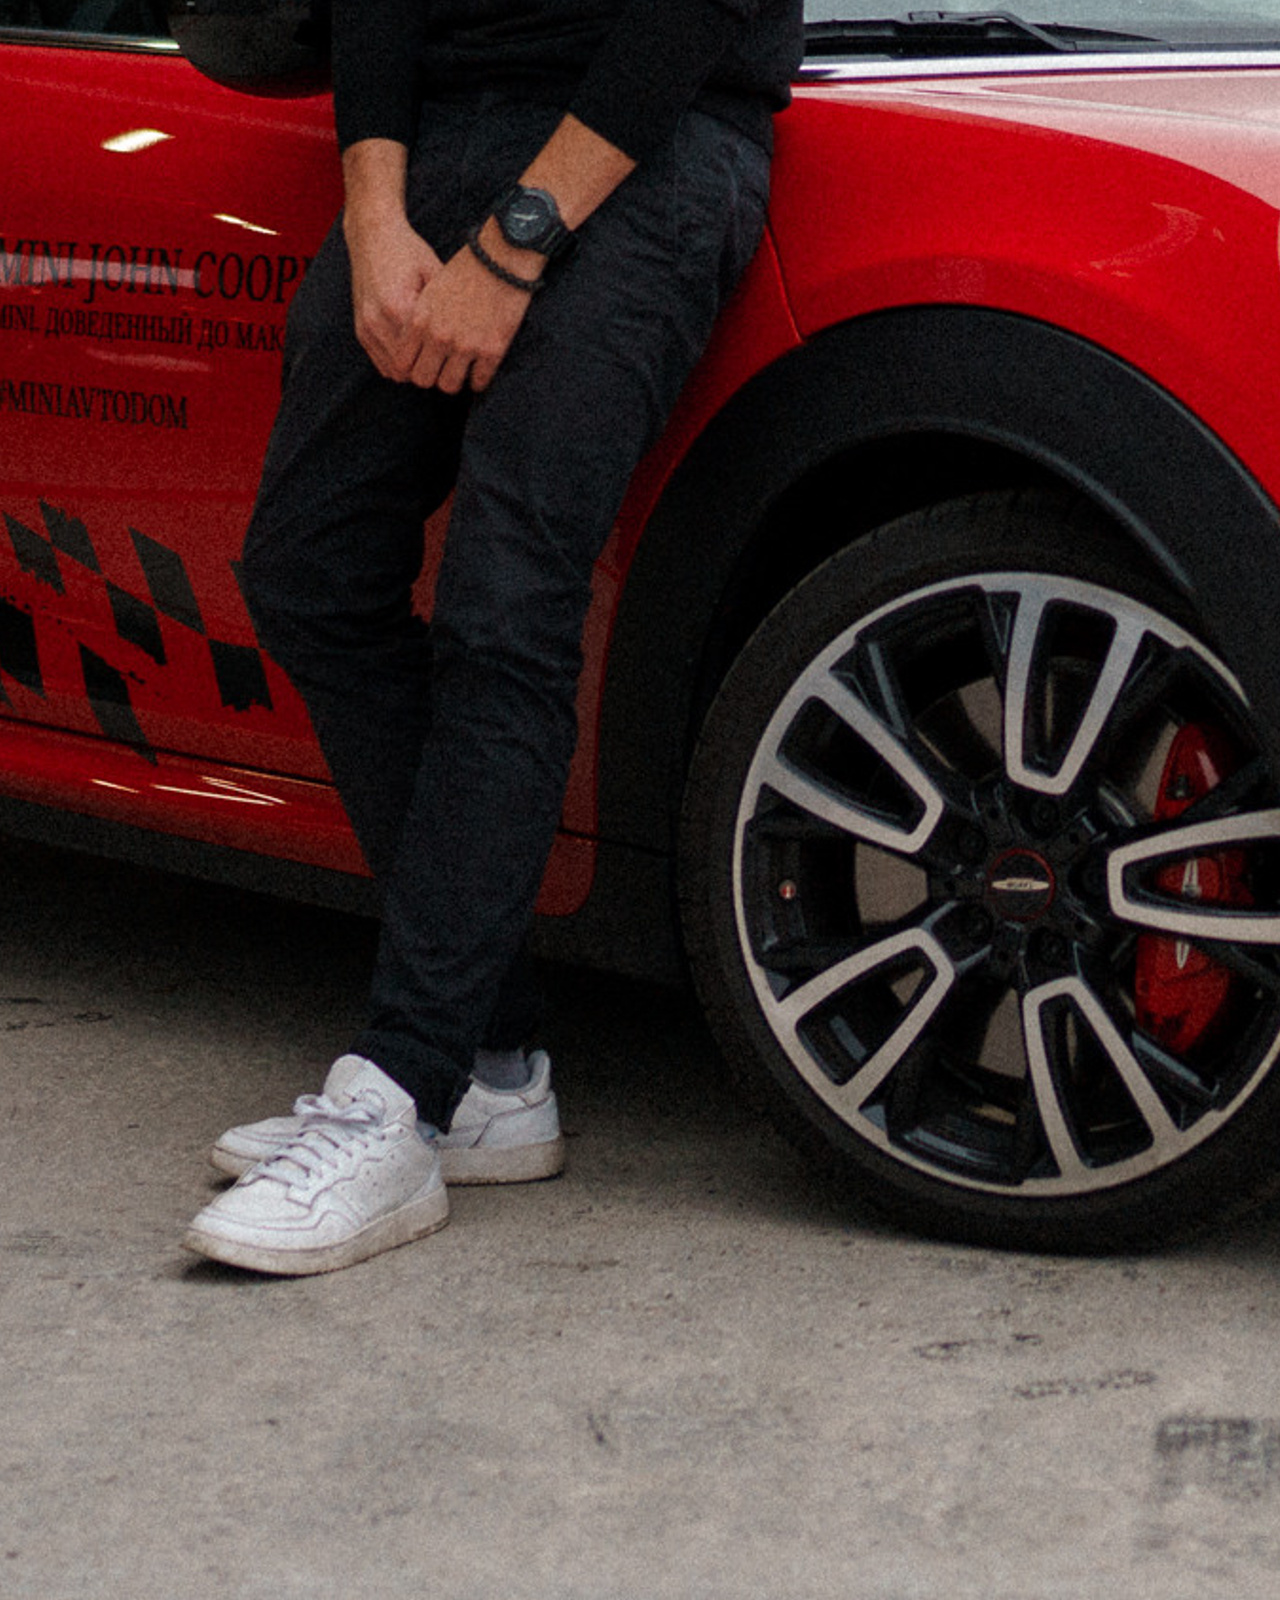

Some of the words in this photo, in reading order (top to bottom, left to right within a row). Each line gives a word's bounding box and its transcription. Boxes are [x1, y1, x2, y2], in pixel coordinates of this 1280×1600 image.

[84, 243, 184, 303] JOHN
[194, 251, 312, 304] COOP
[45, 307, 192, 346] ДОВЕДЕННЫЙ
[197, 319, 229, 352] ДО
